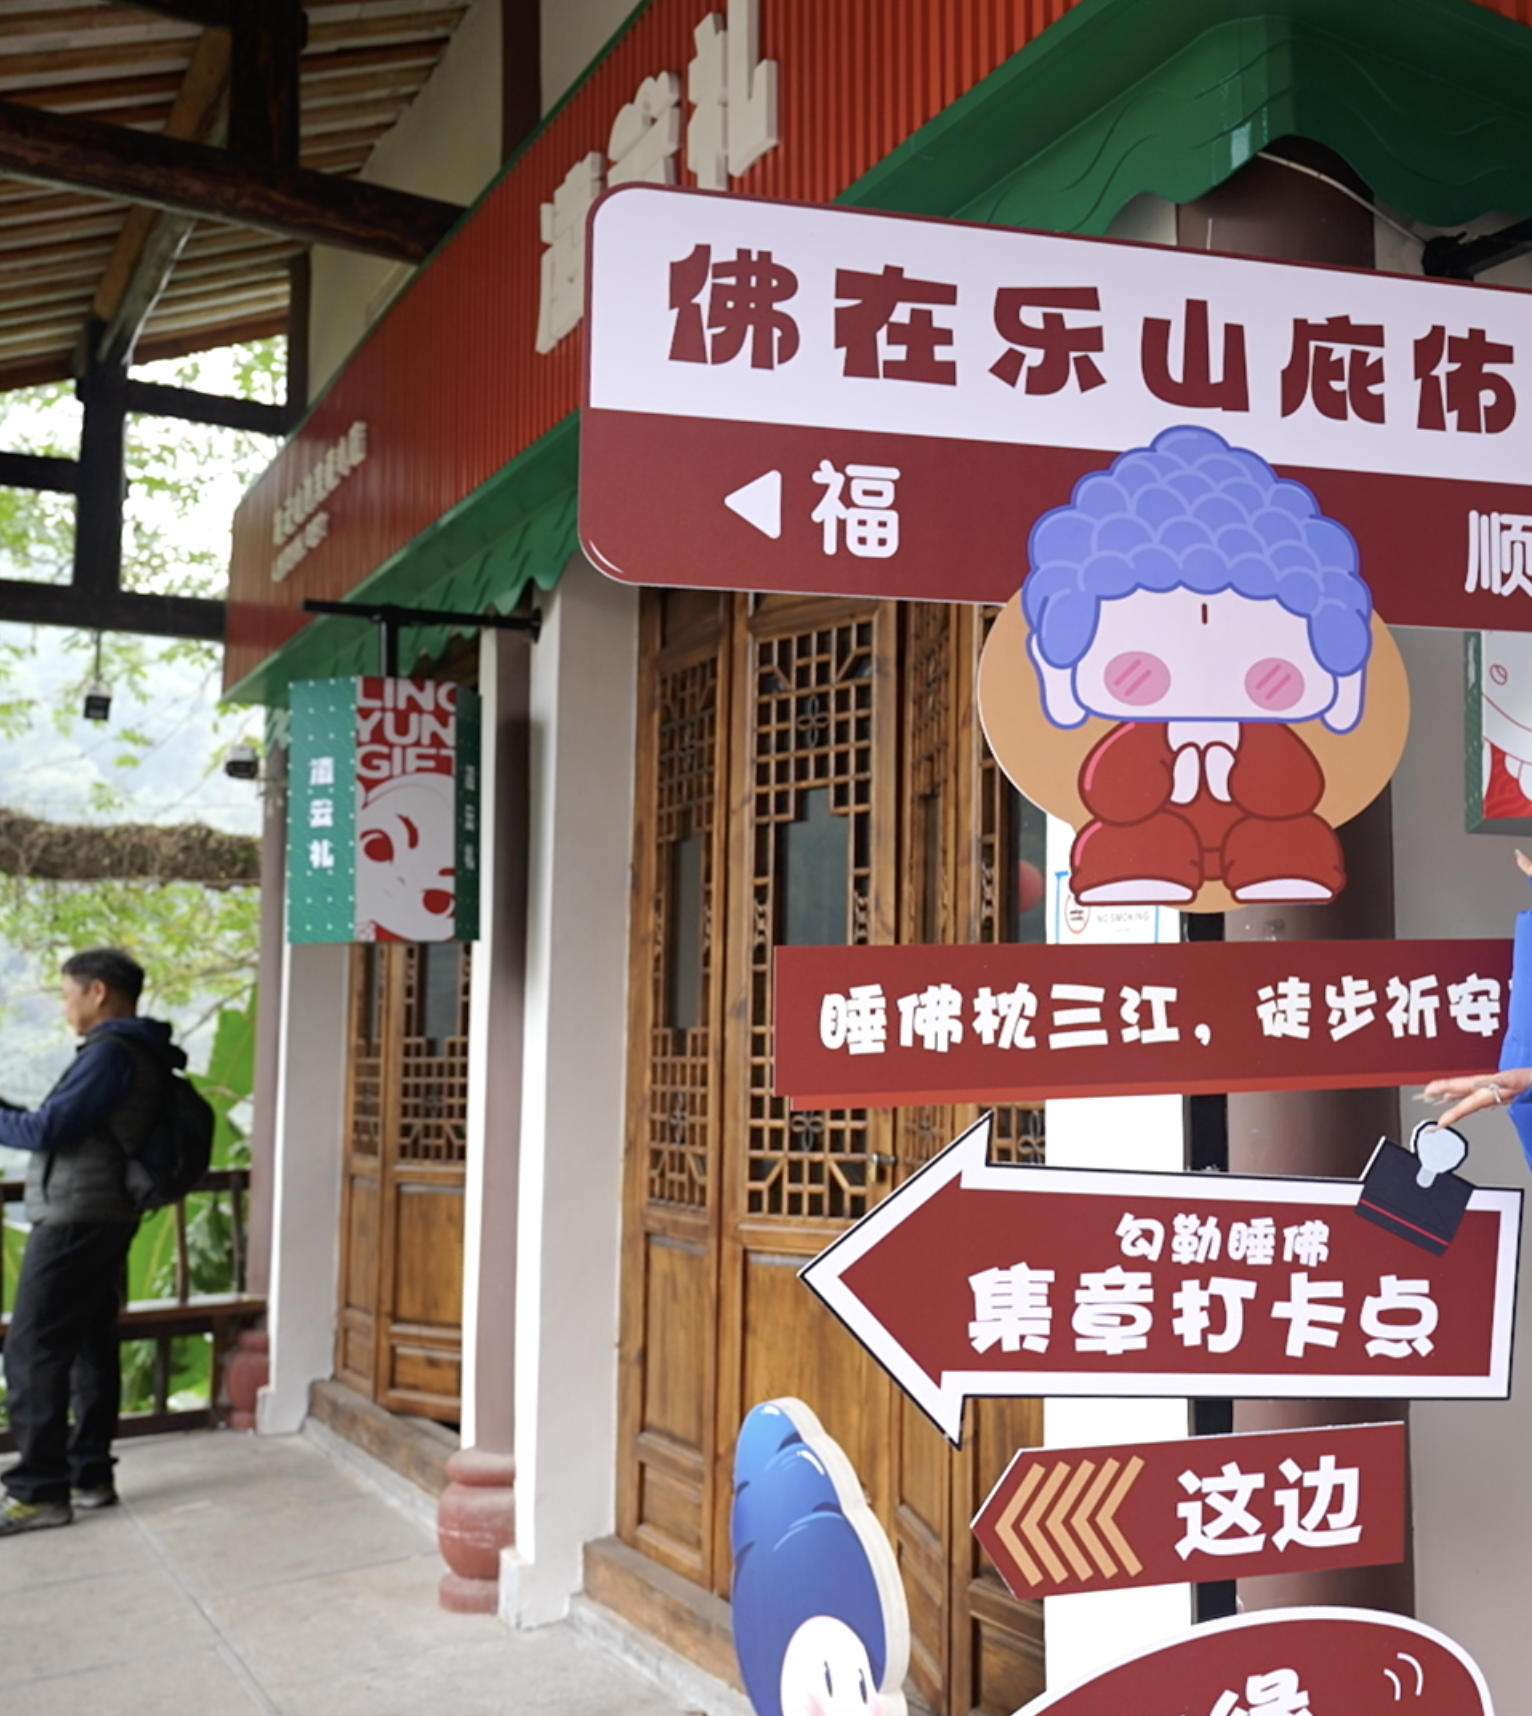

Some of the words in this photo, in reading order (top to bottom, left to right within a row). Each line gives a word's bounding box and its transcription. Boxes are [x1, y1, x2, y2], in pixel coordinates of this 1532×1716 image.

[811, 458, 901, 560] 福
[356, 710, 456, 748] YUN
[819, 972, 1513, 1056] 睡佛枕三江，徒步祈安
[1114, 1212, 1331, 1267] 勾勒睡佛
[966, 1262, 1440, 1358] 集章打卡点
[1173, 1454, 1363, 1561] 这边
